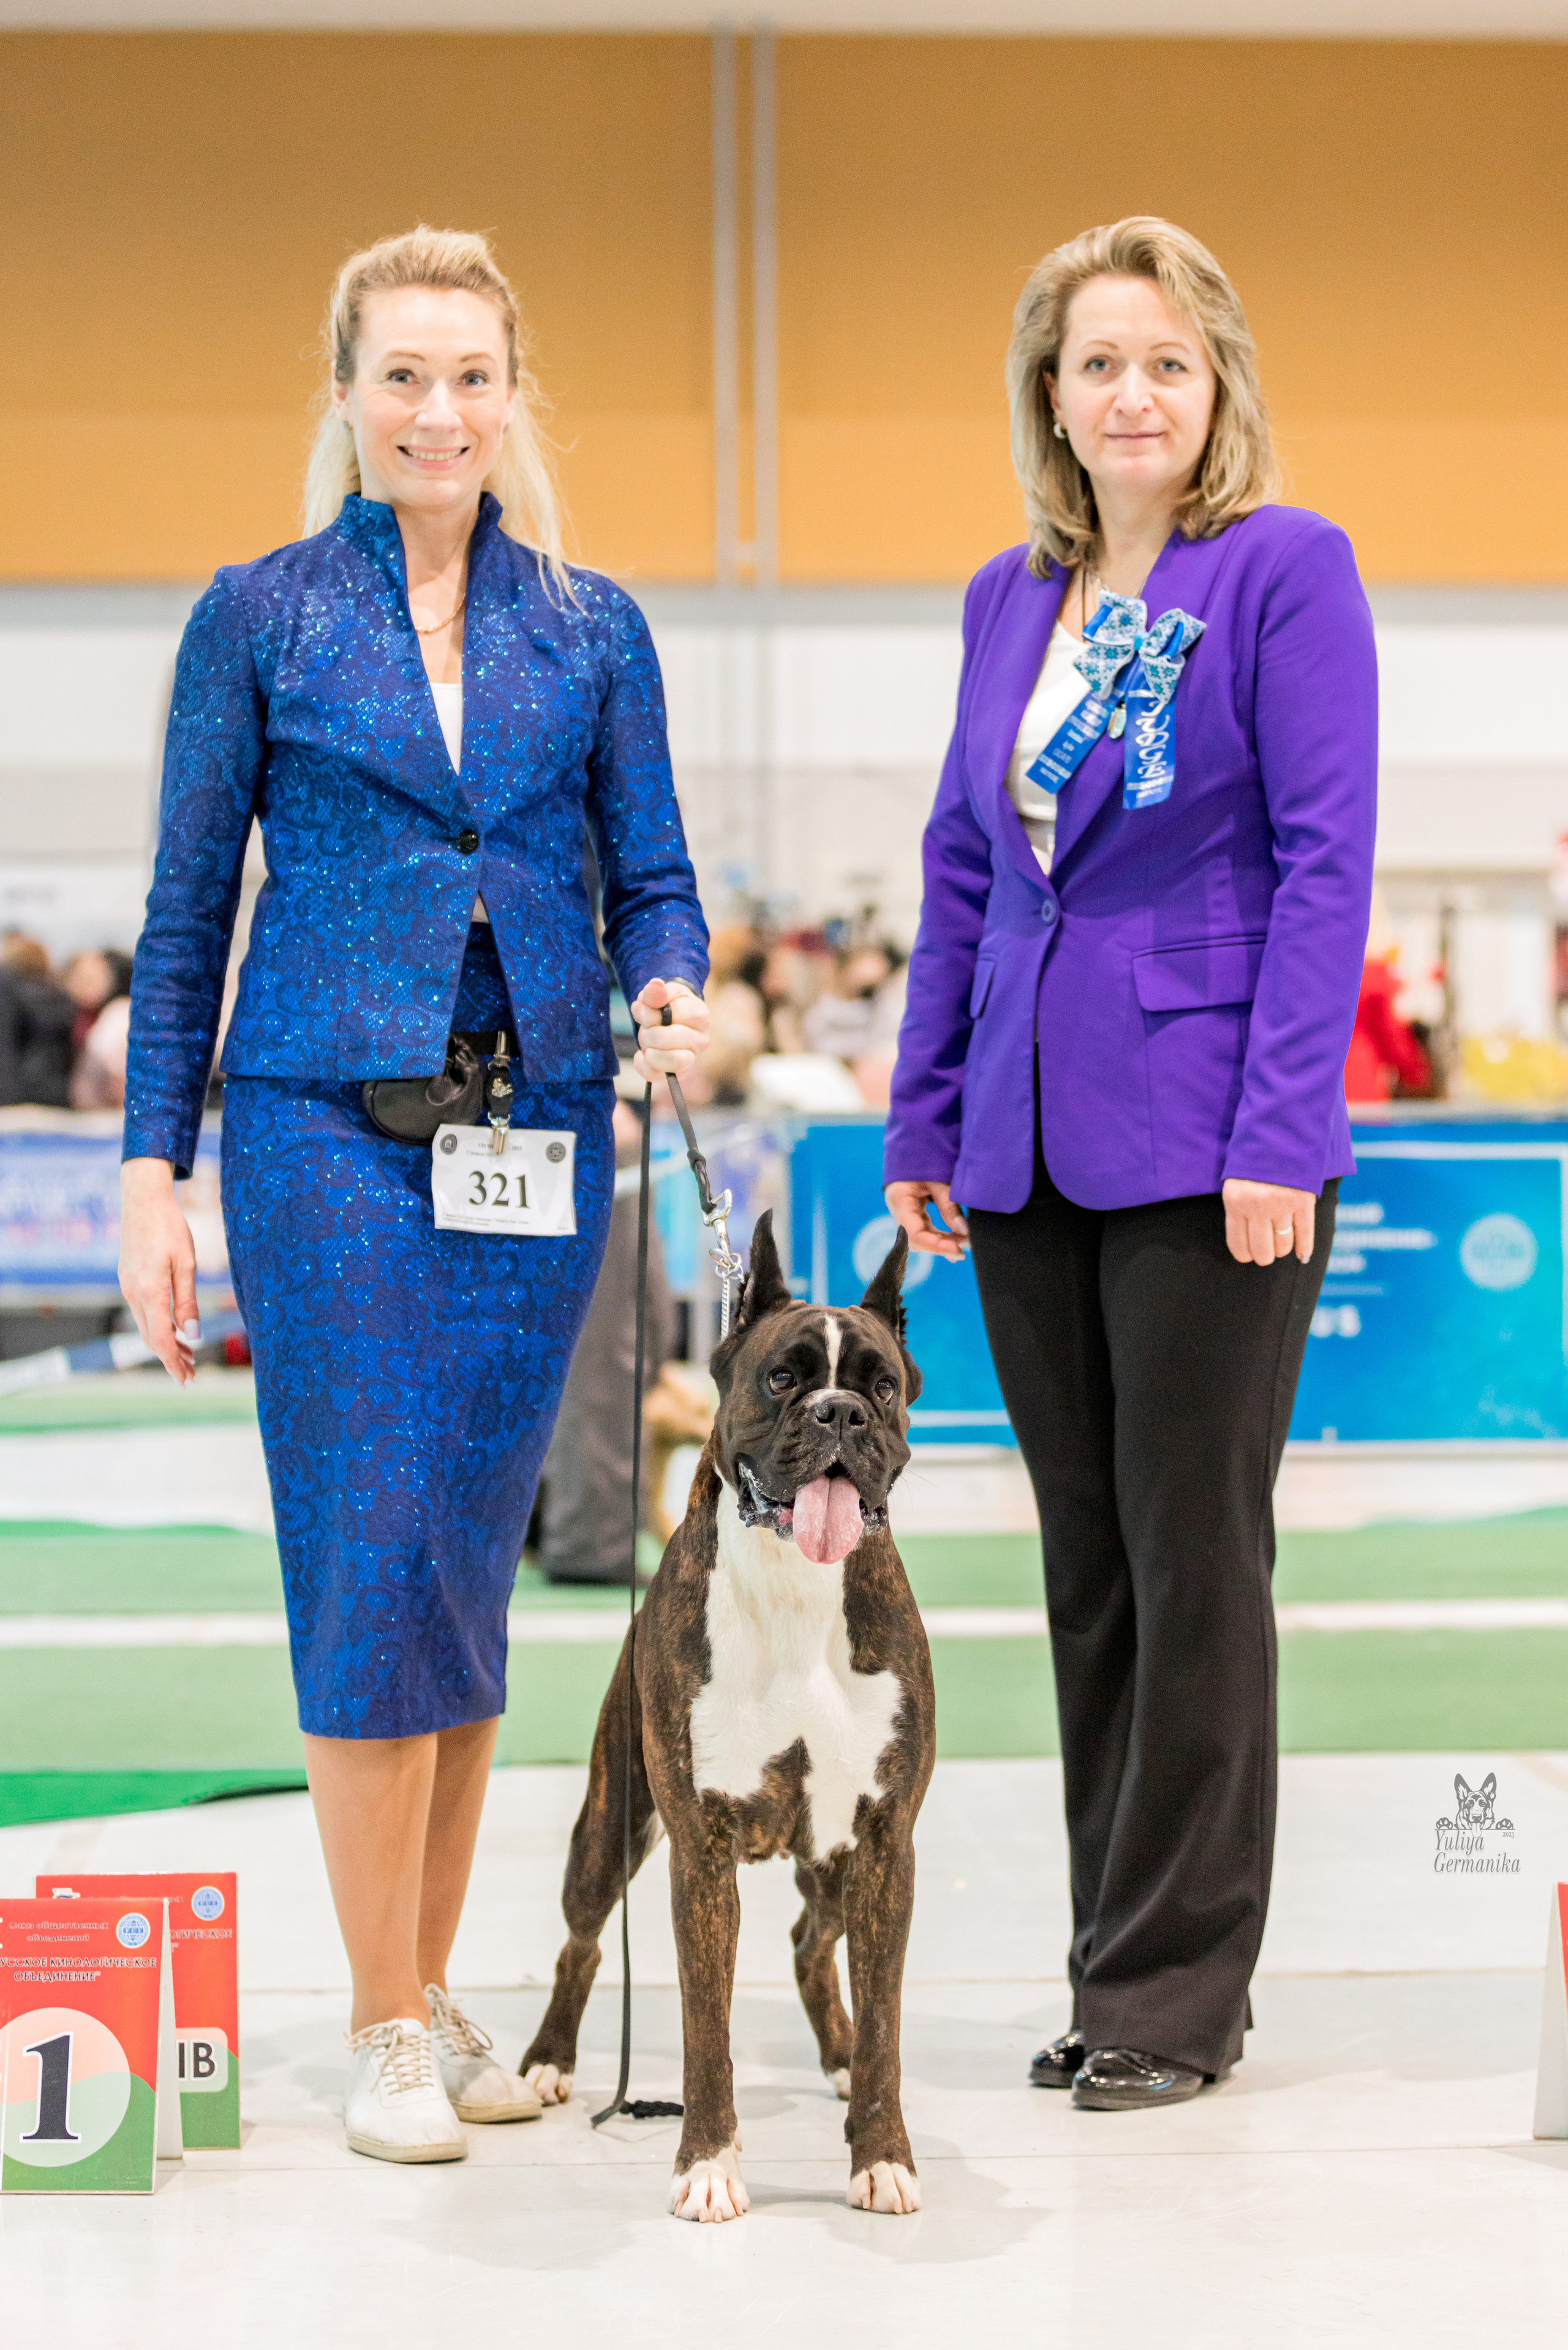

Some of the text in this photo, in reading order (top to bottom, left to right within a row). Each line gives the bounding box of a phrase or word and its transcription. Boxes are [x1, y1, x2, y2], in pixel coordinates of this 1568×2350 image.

[469, 1170, 531, 1209] 321
[36, 1921, 108, 1930] общественных
[26, 1933, 90, 1941] объединений
[50, 1956, 157, 1968] КИНОЛОГИЧЕСКОЕ
[22, 2033, 80, 2142] 1
